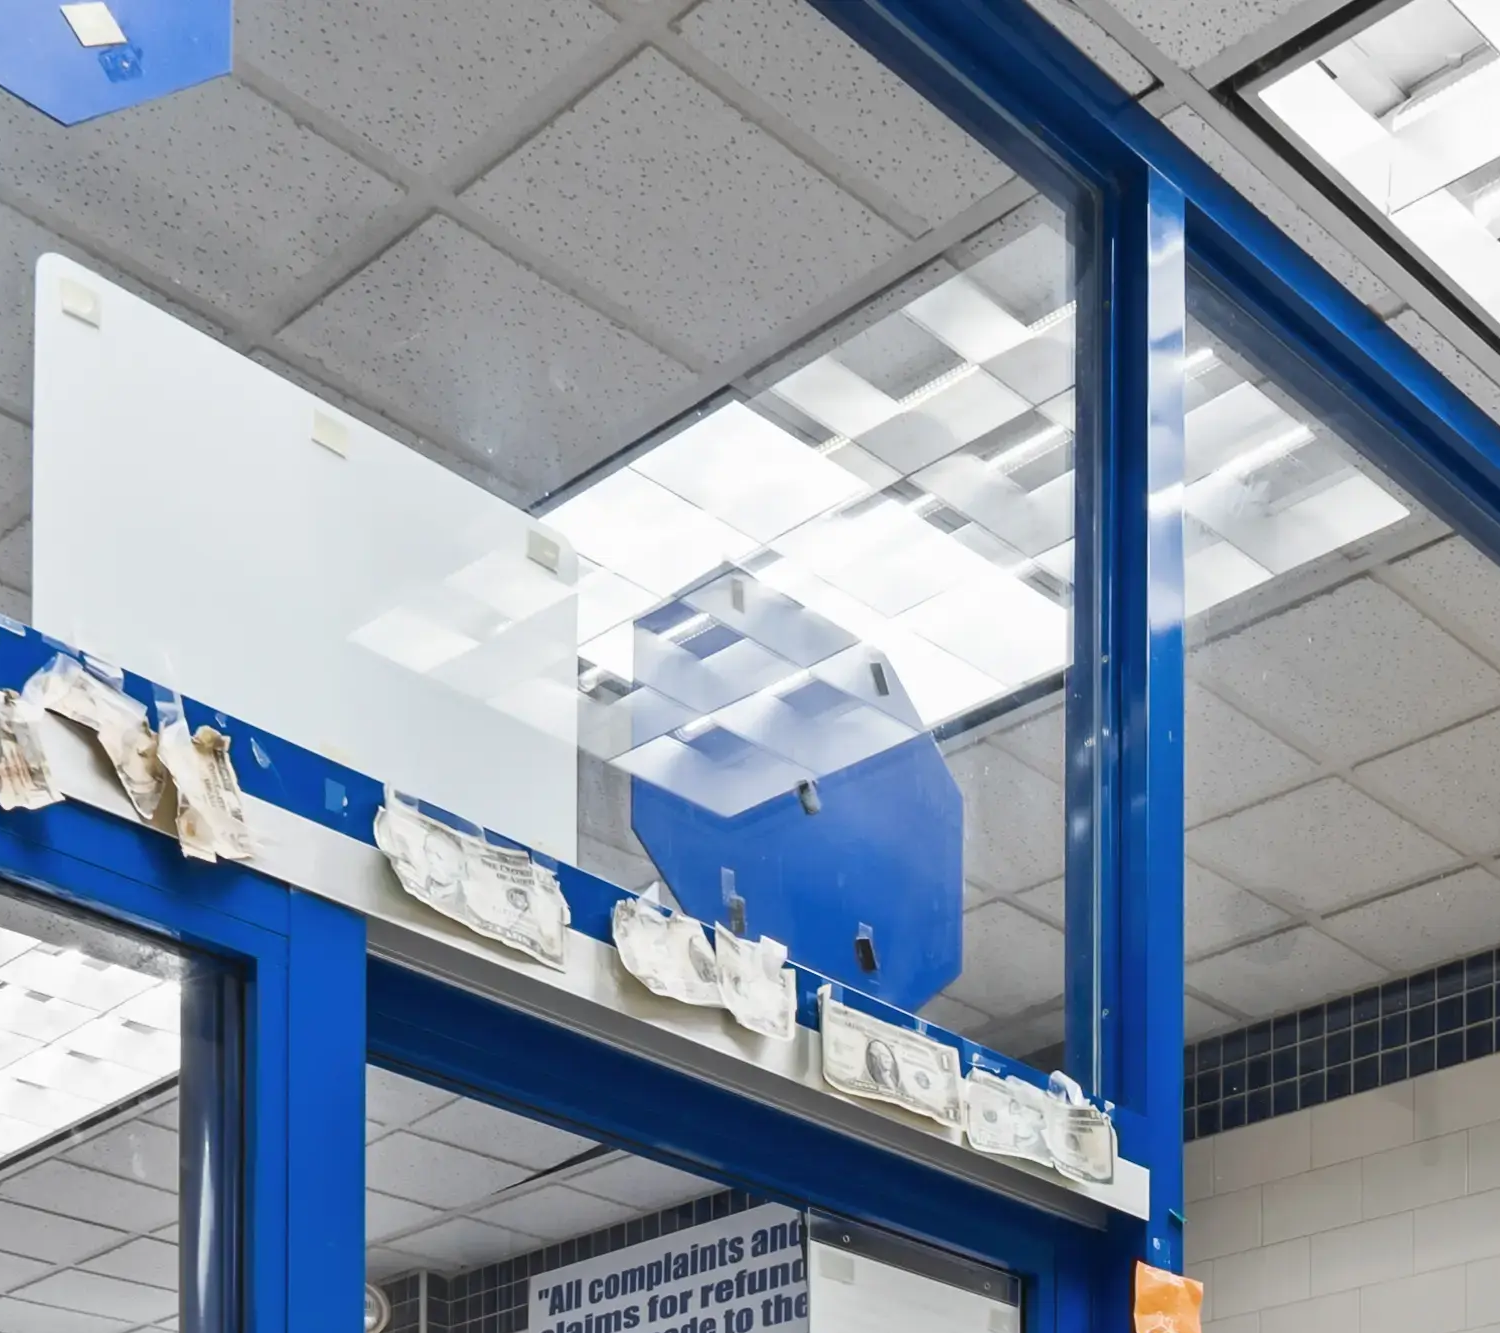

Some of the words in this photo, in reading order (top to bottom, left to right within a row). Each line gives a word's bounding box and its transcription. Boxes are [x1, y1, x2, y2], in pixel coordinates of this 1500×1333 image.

[538, 1279, 582, 1316] "All
[588, 1236, 744, 1305] complaints
[751, 1219, 802, 1258] and
[647, 1289, 693, 1323] for
[761, 1291, 808, 1328] the
